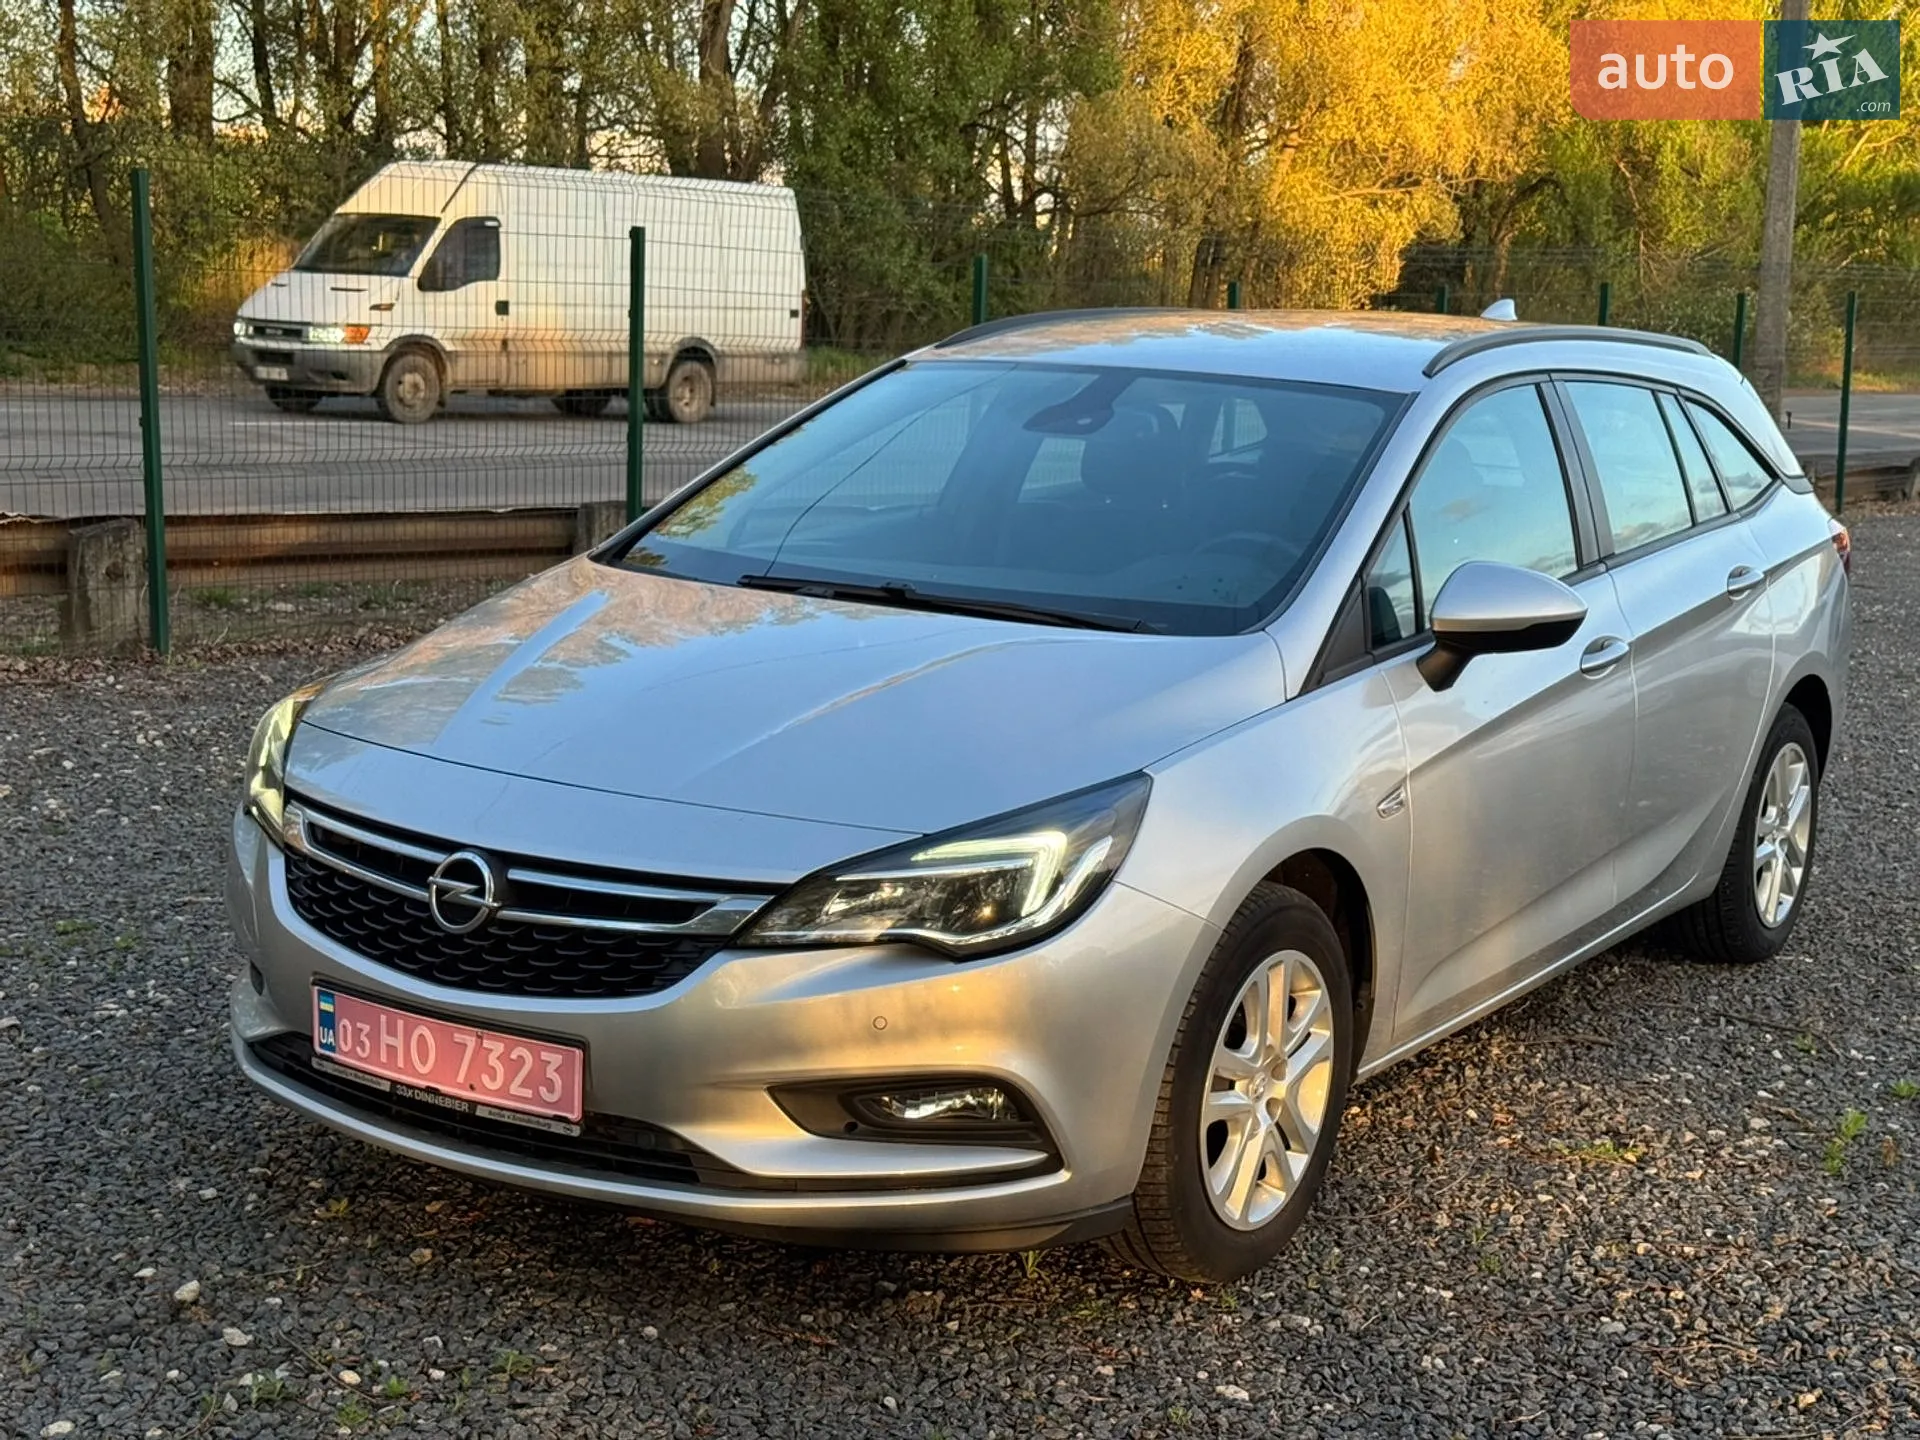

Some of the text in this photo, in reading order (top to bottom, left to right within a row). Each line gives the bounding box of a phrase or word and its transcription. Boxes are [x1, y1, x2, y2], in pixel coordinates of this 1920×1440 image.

[319, 1026, 335, 1047] UA
[338, 1014, 563, 1103] 03 HO 7323
